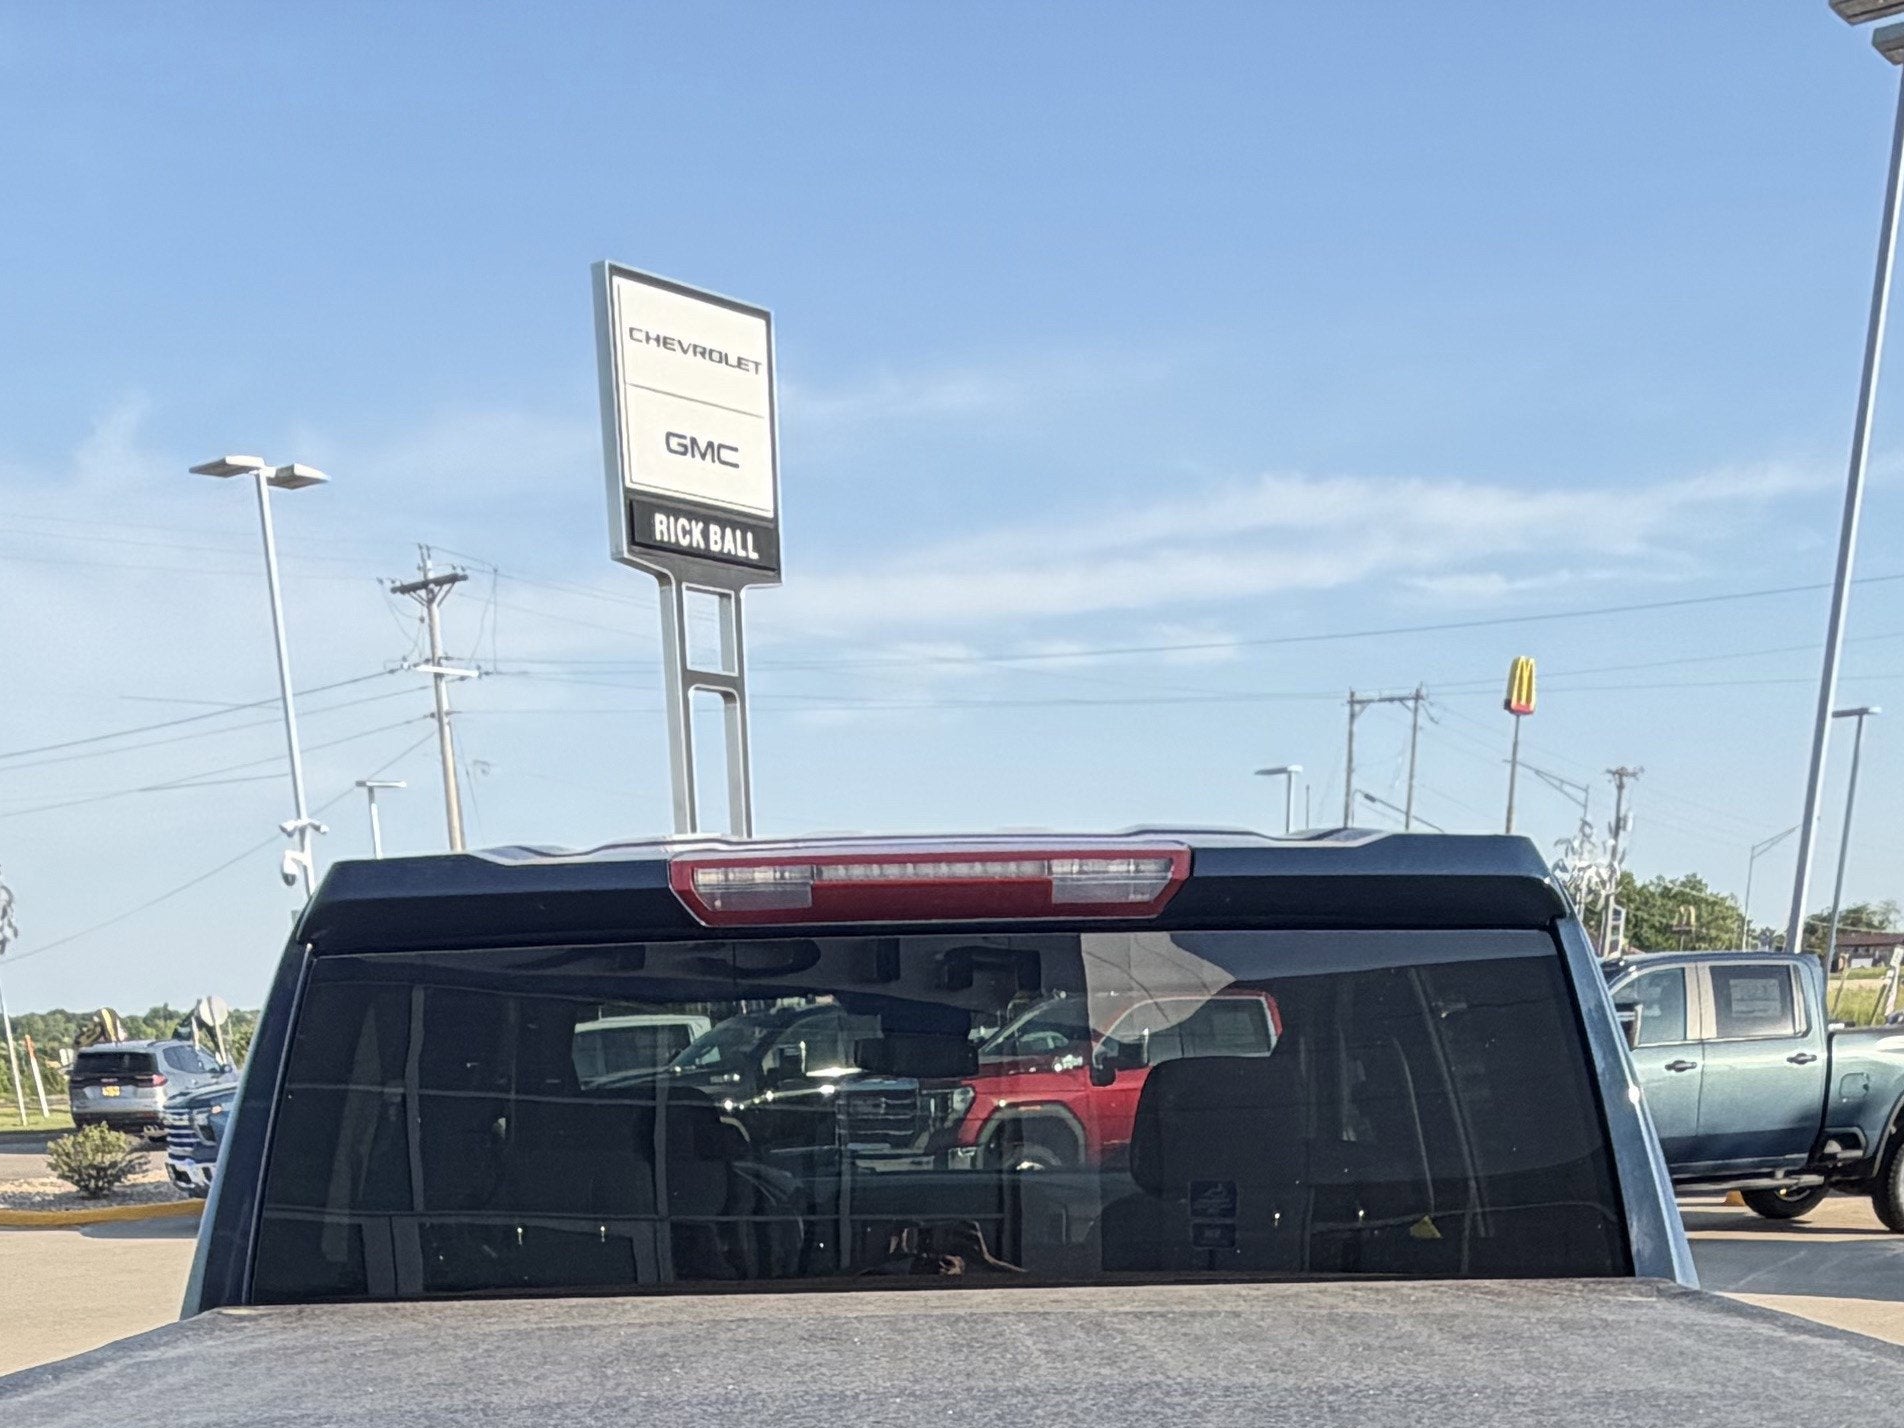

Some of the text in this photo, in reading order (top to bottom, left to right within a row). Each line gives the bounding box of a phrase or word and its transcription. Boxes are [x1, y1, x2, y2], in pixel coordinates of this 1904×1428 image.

[628, 326, 763, 376] CHEVROLET
[665, 430, 740, 469] GMC
[654, 512, 760, 560] RICK BALL
